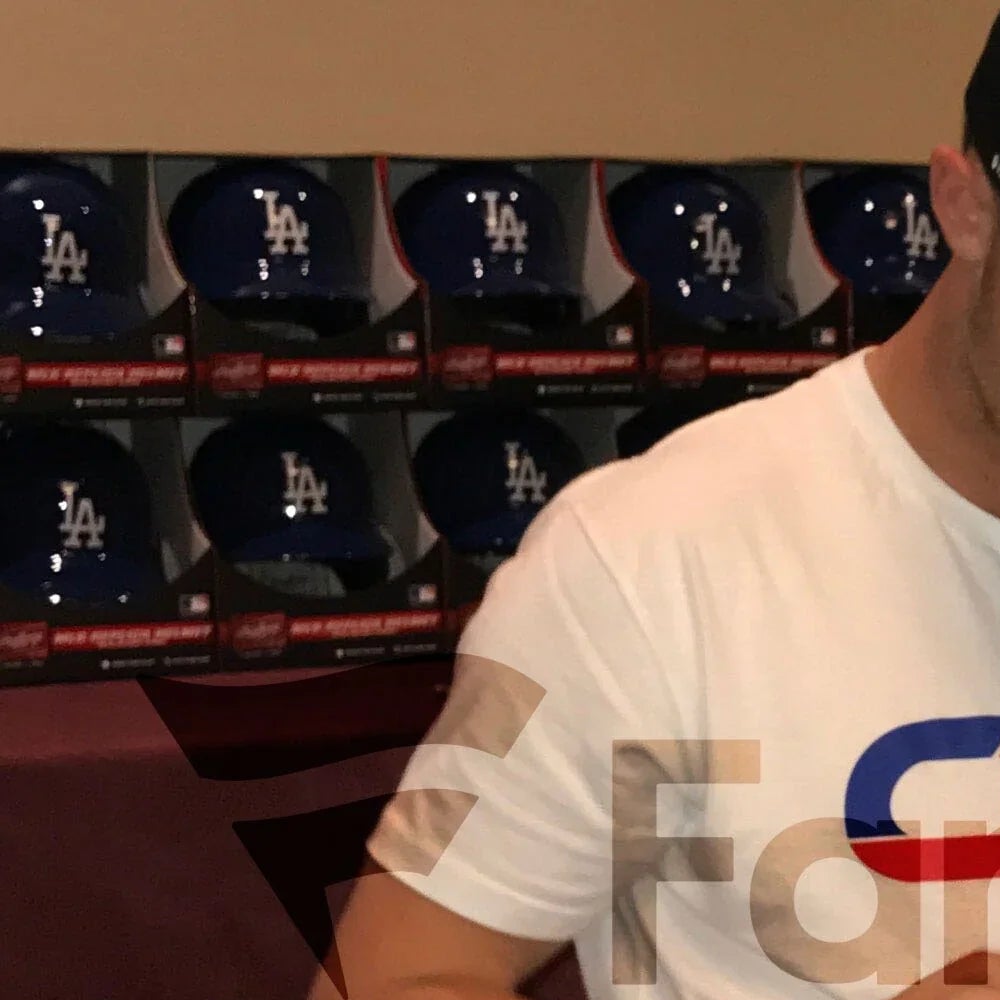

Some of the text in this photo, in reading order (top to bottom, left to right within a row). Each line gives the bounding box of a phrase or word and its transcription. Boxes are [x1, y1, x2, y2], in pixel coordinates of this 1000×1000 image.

[41, 213, 88, 284] LA
[262, 190, 310, 255] LA
[482, 191, 529, 253] LA
[695, 213, 743, 275] LA
[902, 195, 939, 260] LA
[281, 451, 328, 514] LA
[504, 441, 548, 501] LA
[60, 480, 105, 548] LA
